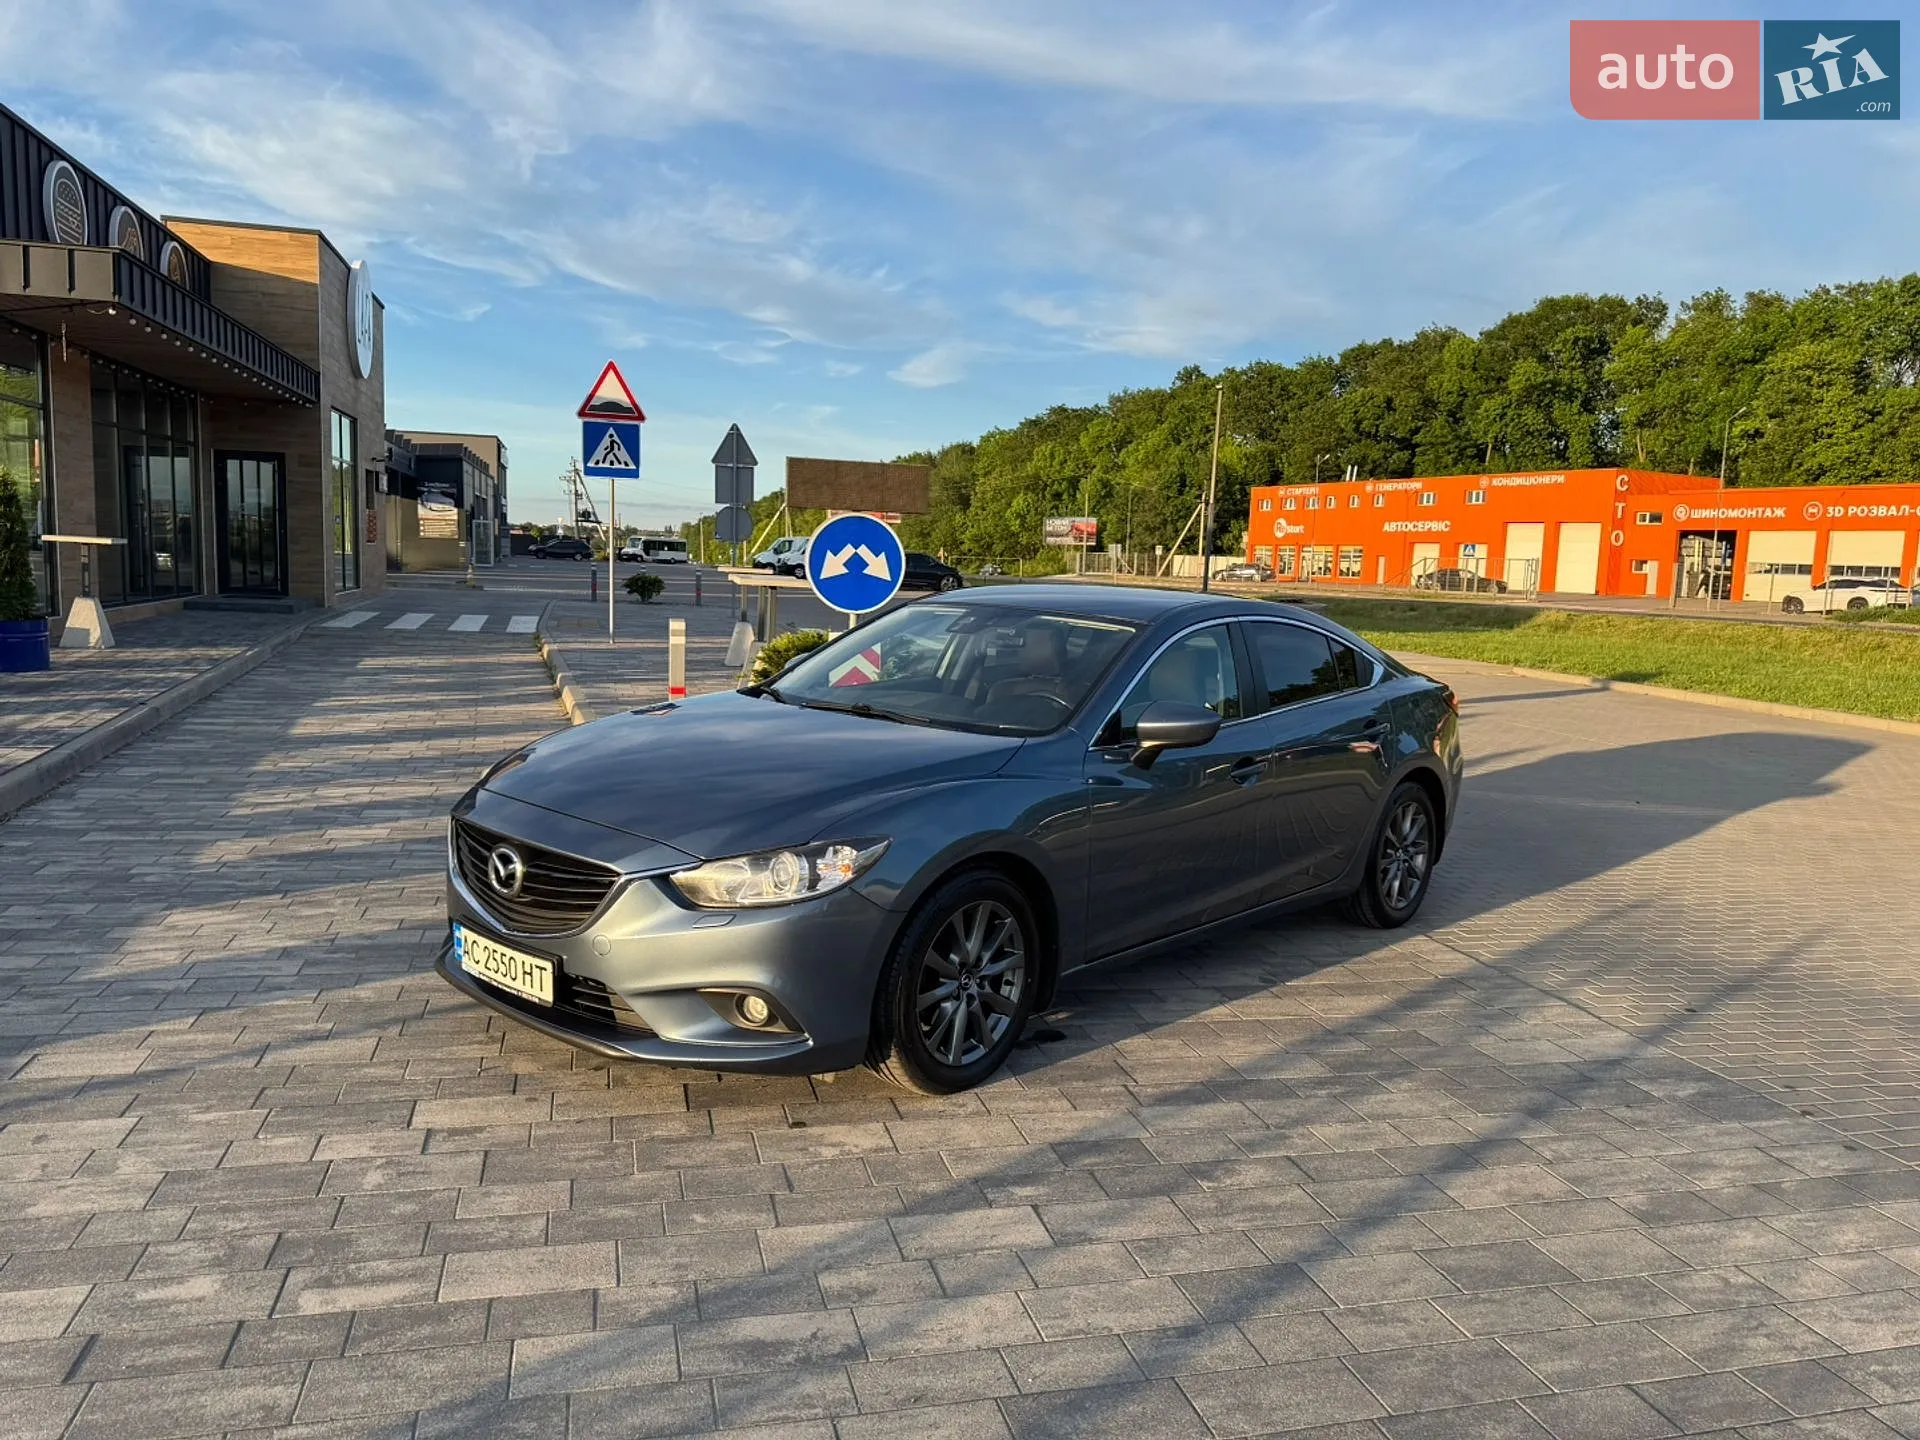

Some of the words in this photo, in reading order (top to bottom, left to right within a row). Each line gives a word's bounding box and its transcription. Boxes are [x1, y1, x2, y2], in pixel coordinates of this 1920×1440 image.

[1375, 482, 1422, 492] ГЕНЕРАТОРИ
[1491, 475, 1564, 487] КОНДИЦІОНЕРИ
[1690, 506, 1787, 519] ШИНОМОНТАЖ
[1826, 505, 1844, 518] 3D
[1382, 520, 1451, 532] АВТОСЕРВІС
[463, 936, 480, 964] AC
[483, 946, 517, 981] 2550
[522, 960, 547, 992] HT
